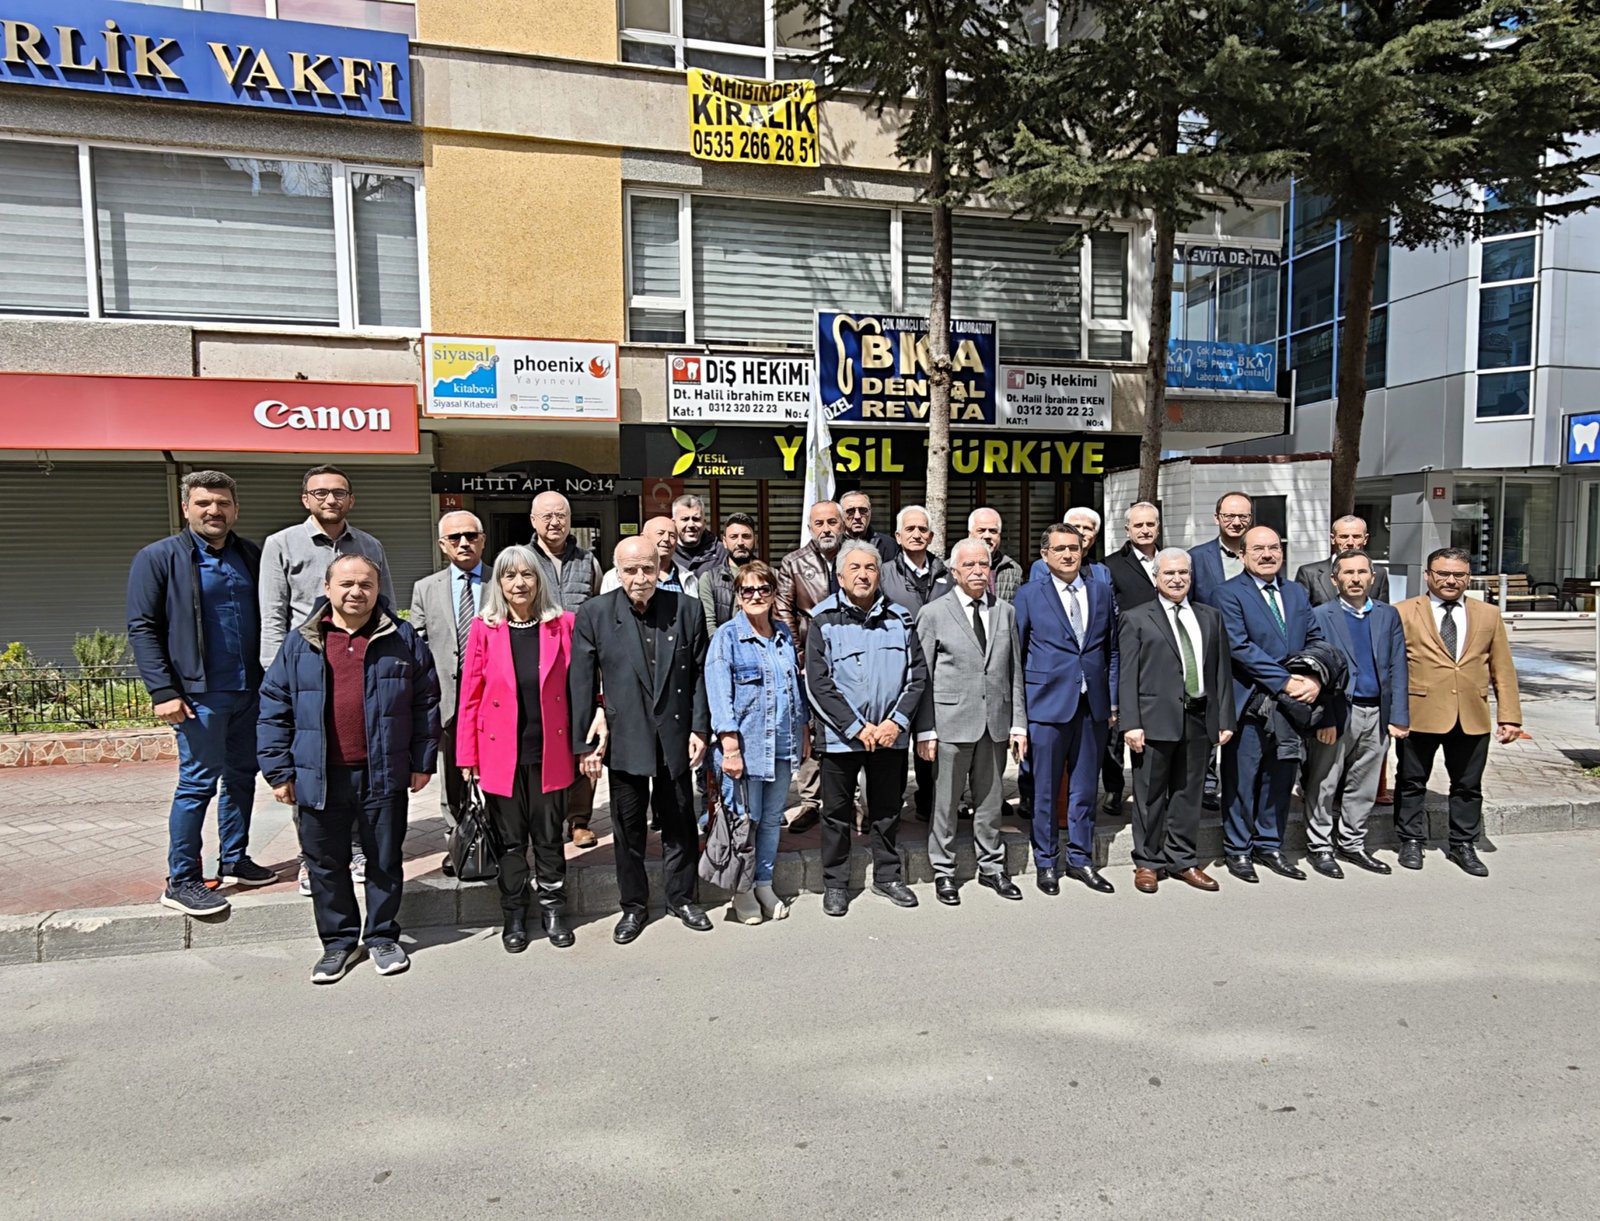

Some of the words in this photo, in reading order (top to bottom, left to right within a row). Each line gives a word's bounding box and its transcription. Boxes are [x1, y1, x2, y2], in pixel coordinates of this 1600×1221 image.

[206, 42, 400, 101] VAKFI
[694, 129, 734, 158] 0535
[740, 132, 770, 160] 266
[775, 134, 794, 161] 28
[799, 137, 816, 163] 51
[433, 345, 489, 364] siyasal
[1237, 354, 1264, 369] BKA
[513, 355, 585, 375] phoenix
[1236, 368, 1265, 377] Dental
[453, 382, 495, 394] kitabevi
[861, 377, 986, 399] DENAL
[1026, 373, 1047, 388] Diş
[1051, 374, 1097, 388] Hekimi
[673, 389, 691, 400] Dt.
[694, 389, 724, 400] Halil
[778, 391, 810, 402] EKEN
[1006, 394, 1019, 403] Dt.
[1021, 394, 1042, 403] Halil
[1080, 396, 1105, 405] EKEN
[433, 399, 462, 409] Siyasal
[463, 399, 498, 409] Kitabevi
[708, 403, 732, 413] 0312
[733, 404, 751, 413] 320
[753, 404, 765, 413] 22
[766, 404, 778, 414] 23
[822, 396, 853, 420] ÖZEL
[861, 400, 986, 420] REVTA
[1017, 405, 1042, 415] 0312
[1045, 406, 1064, 416] 320
[1066, 407, 1079, 416] 22
[1081, 407, 1094, 417] 23
[253, 400, 391, 431] Canon
[773, 436, 904, 472] YSiL
[923, 439, 1105, 474] ÜRKiYE
[566, 479, 614, 492] NO:14
[445, 497, 456, 506] 14
